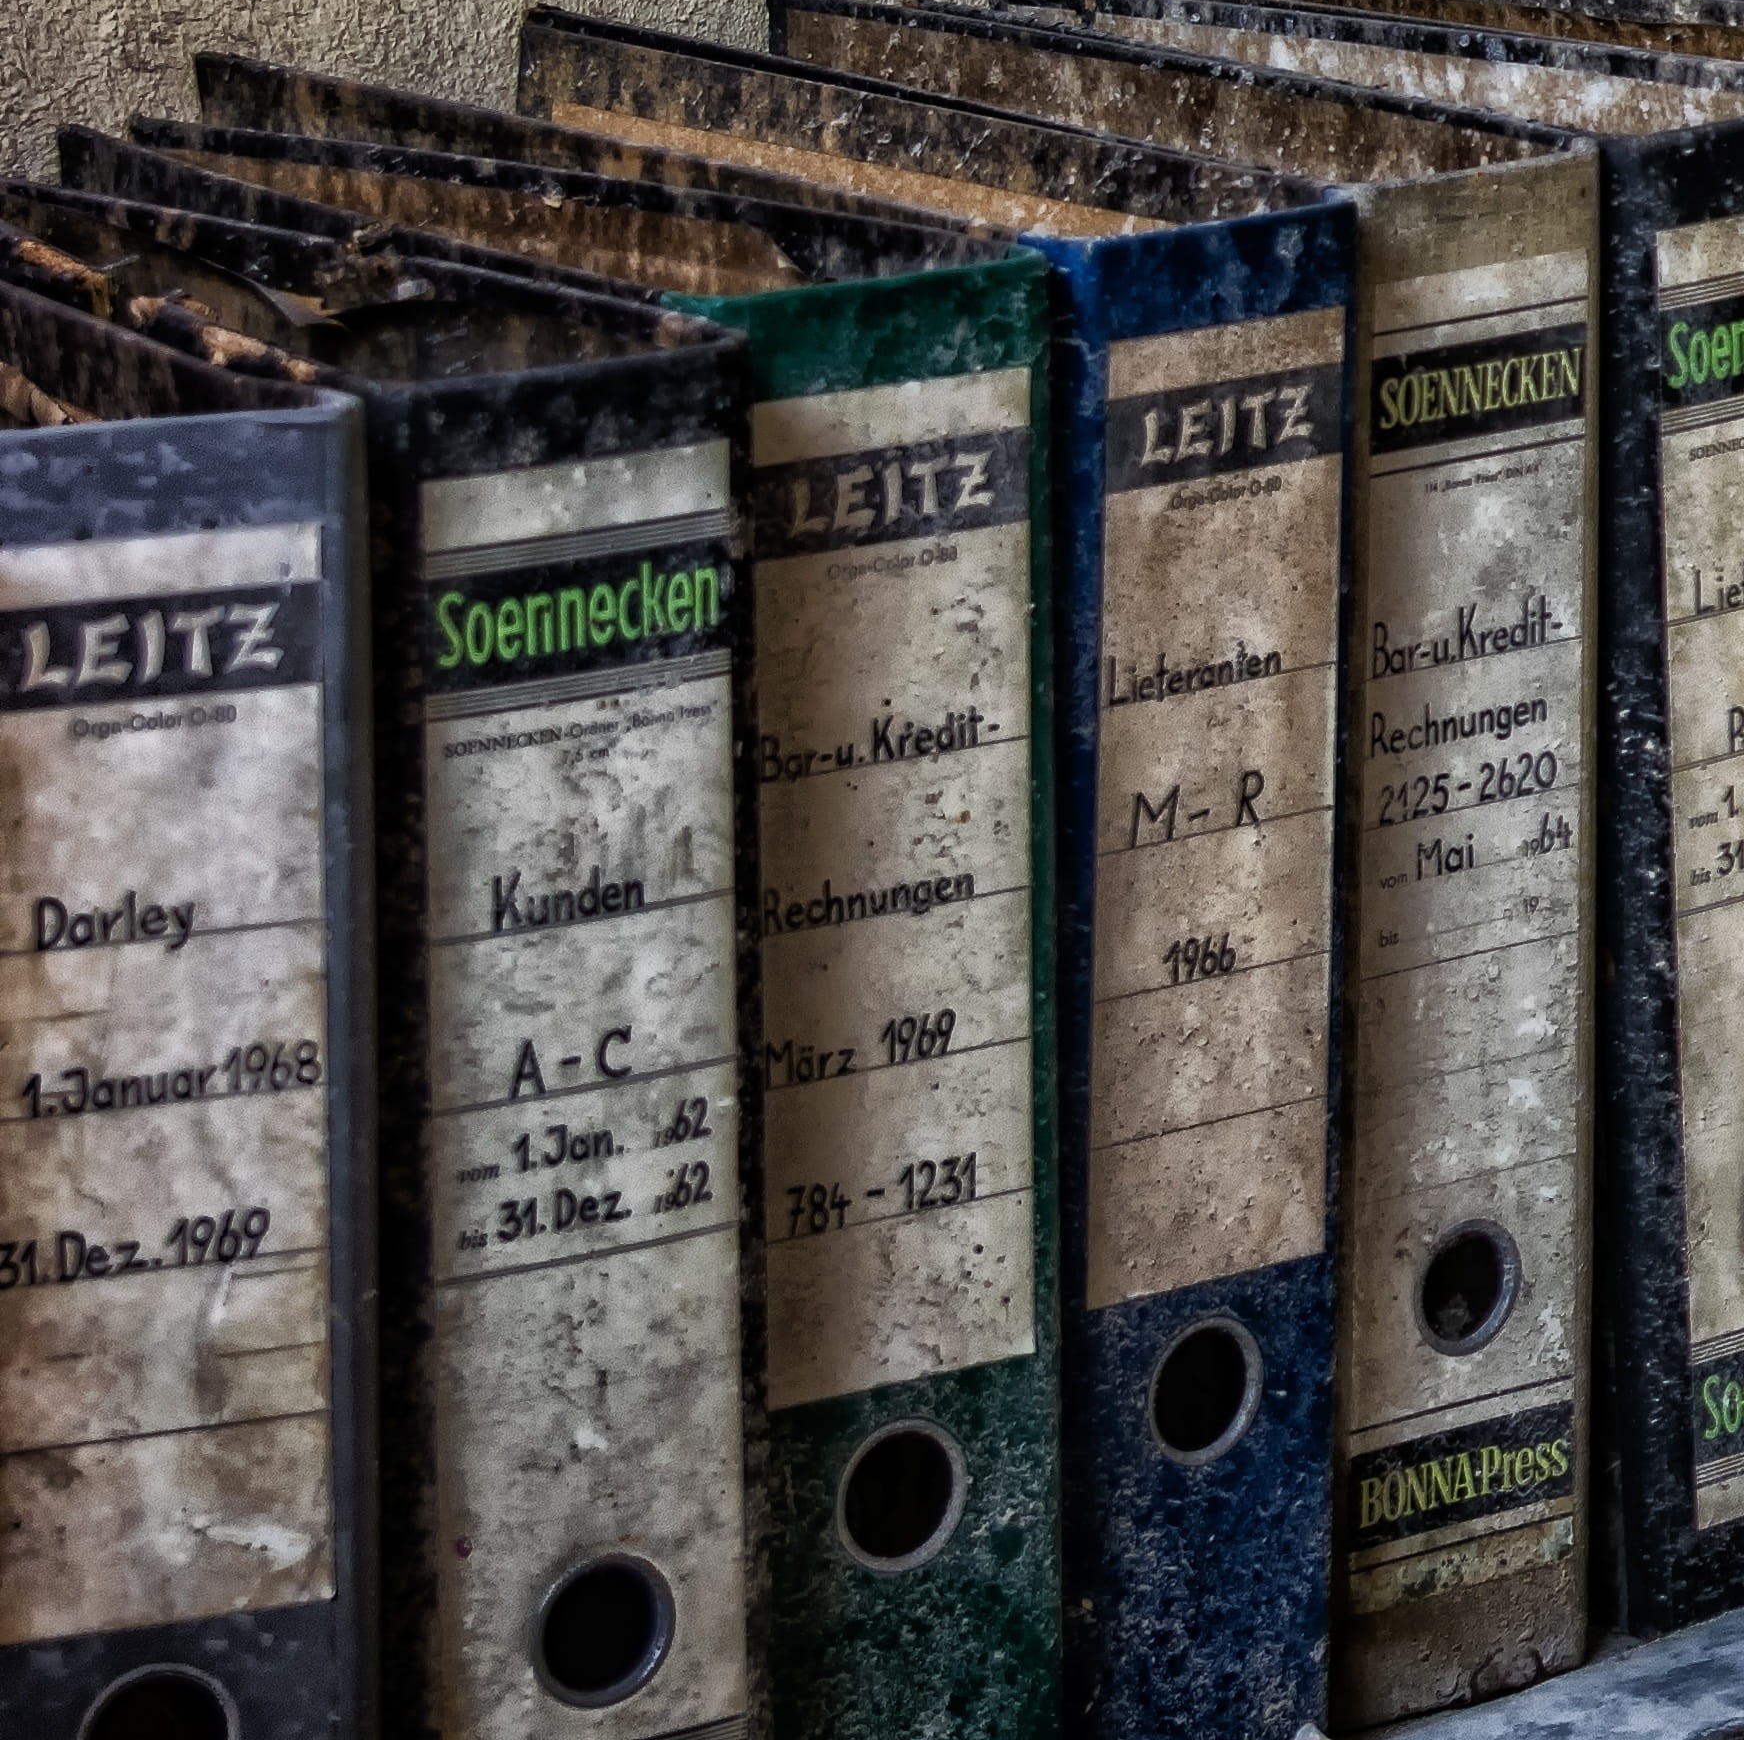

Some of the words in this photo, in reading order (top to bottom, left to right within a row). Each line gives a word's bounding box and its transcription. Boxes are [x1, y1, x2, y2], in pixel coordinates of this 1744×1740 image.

[1379, 348, 1584, 430] SOENNECKEN
[1140, 382, 1315, 468] LEITZ
[787, 450, 997, 539] LEITZ
[22, 602, 285, 692] LEITZ
[436, 559, 720, 669] Soennecken
[1371, 698, 1547, 759] Rechnungen
[1131, 785, 1181, 849] M
[1236, 770, 1266, 828] R
[1379, 773, 1450, 828] 2125
[1479, 750, 1558, 802] 2620
[1417, 833, 1475, 880] Mai
[37, 890, 196, 951] Darley
[491, 865, 645, 932] Kunden
[764, 870, 976, 939] Rechnungen
[1163, 931, 1238, 984] 1966
[222, 1038, 322, 1091] 1968
[510, 1039, 546, 1098] A
[599, 1024, 633, 1078] C
[879, 1007, 957, 1065] 1969
[786, 1182, 852, 1235] 784
[901, 1152, 977, 1210] 1231
[166, 1207, 271, 1267] 1969
[458, 1227, 489, 1250] bis
